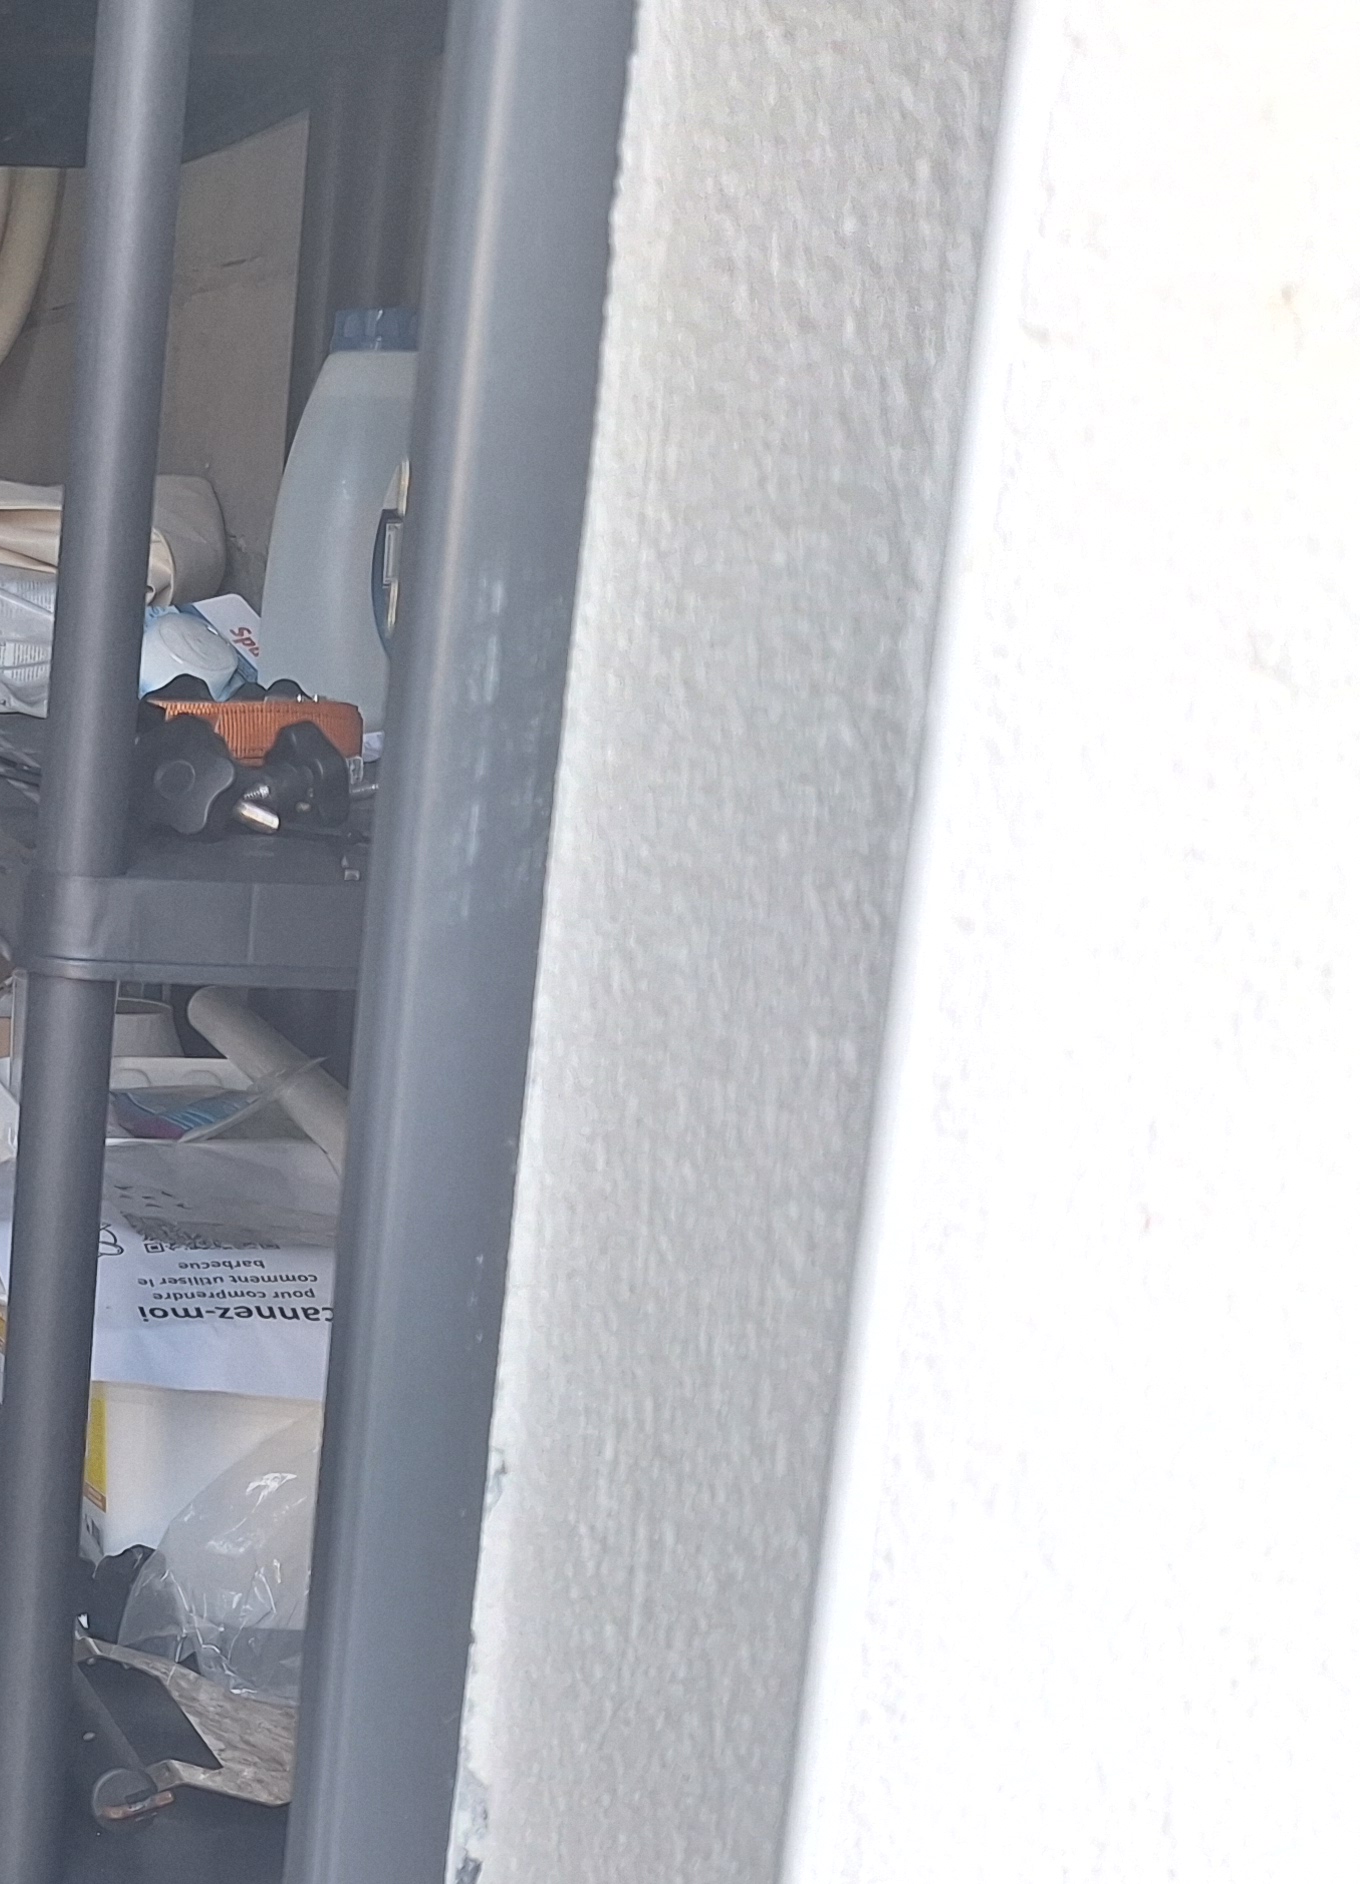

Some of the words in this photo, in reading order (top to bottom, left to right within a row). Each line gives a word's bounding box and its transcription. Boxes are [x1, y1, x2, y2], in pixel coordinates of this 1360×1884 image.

[178, 1259, 266, 1270] barbecue
[137, 1277, 154, 1288] le
[159, 1275, 224, 1286] utiliser
[229, 1274, 318, 1284] comment
[152, 1289, 267, 1302] comprendre
[272, 1288, 316, 1300] pour
[137, 1305, 335, 1323] cannez-moi
